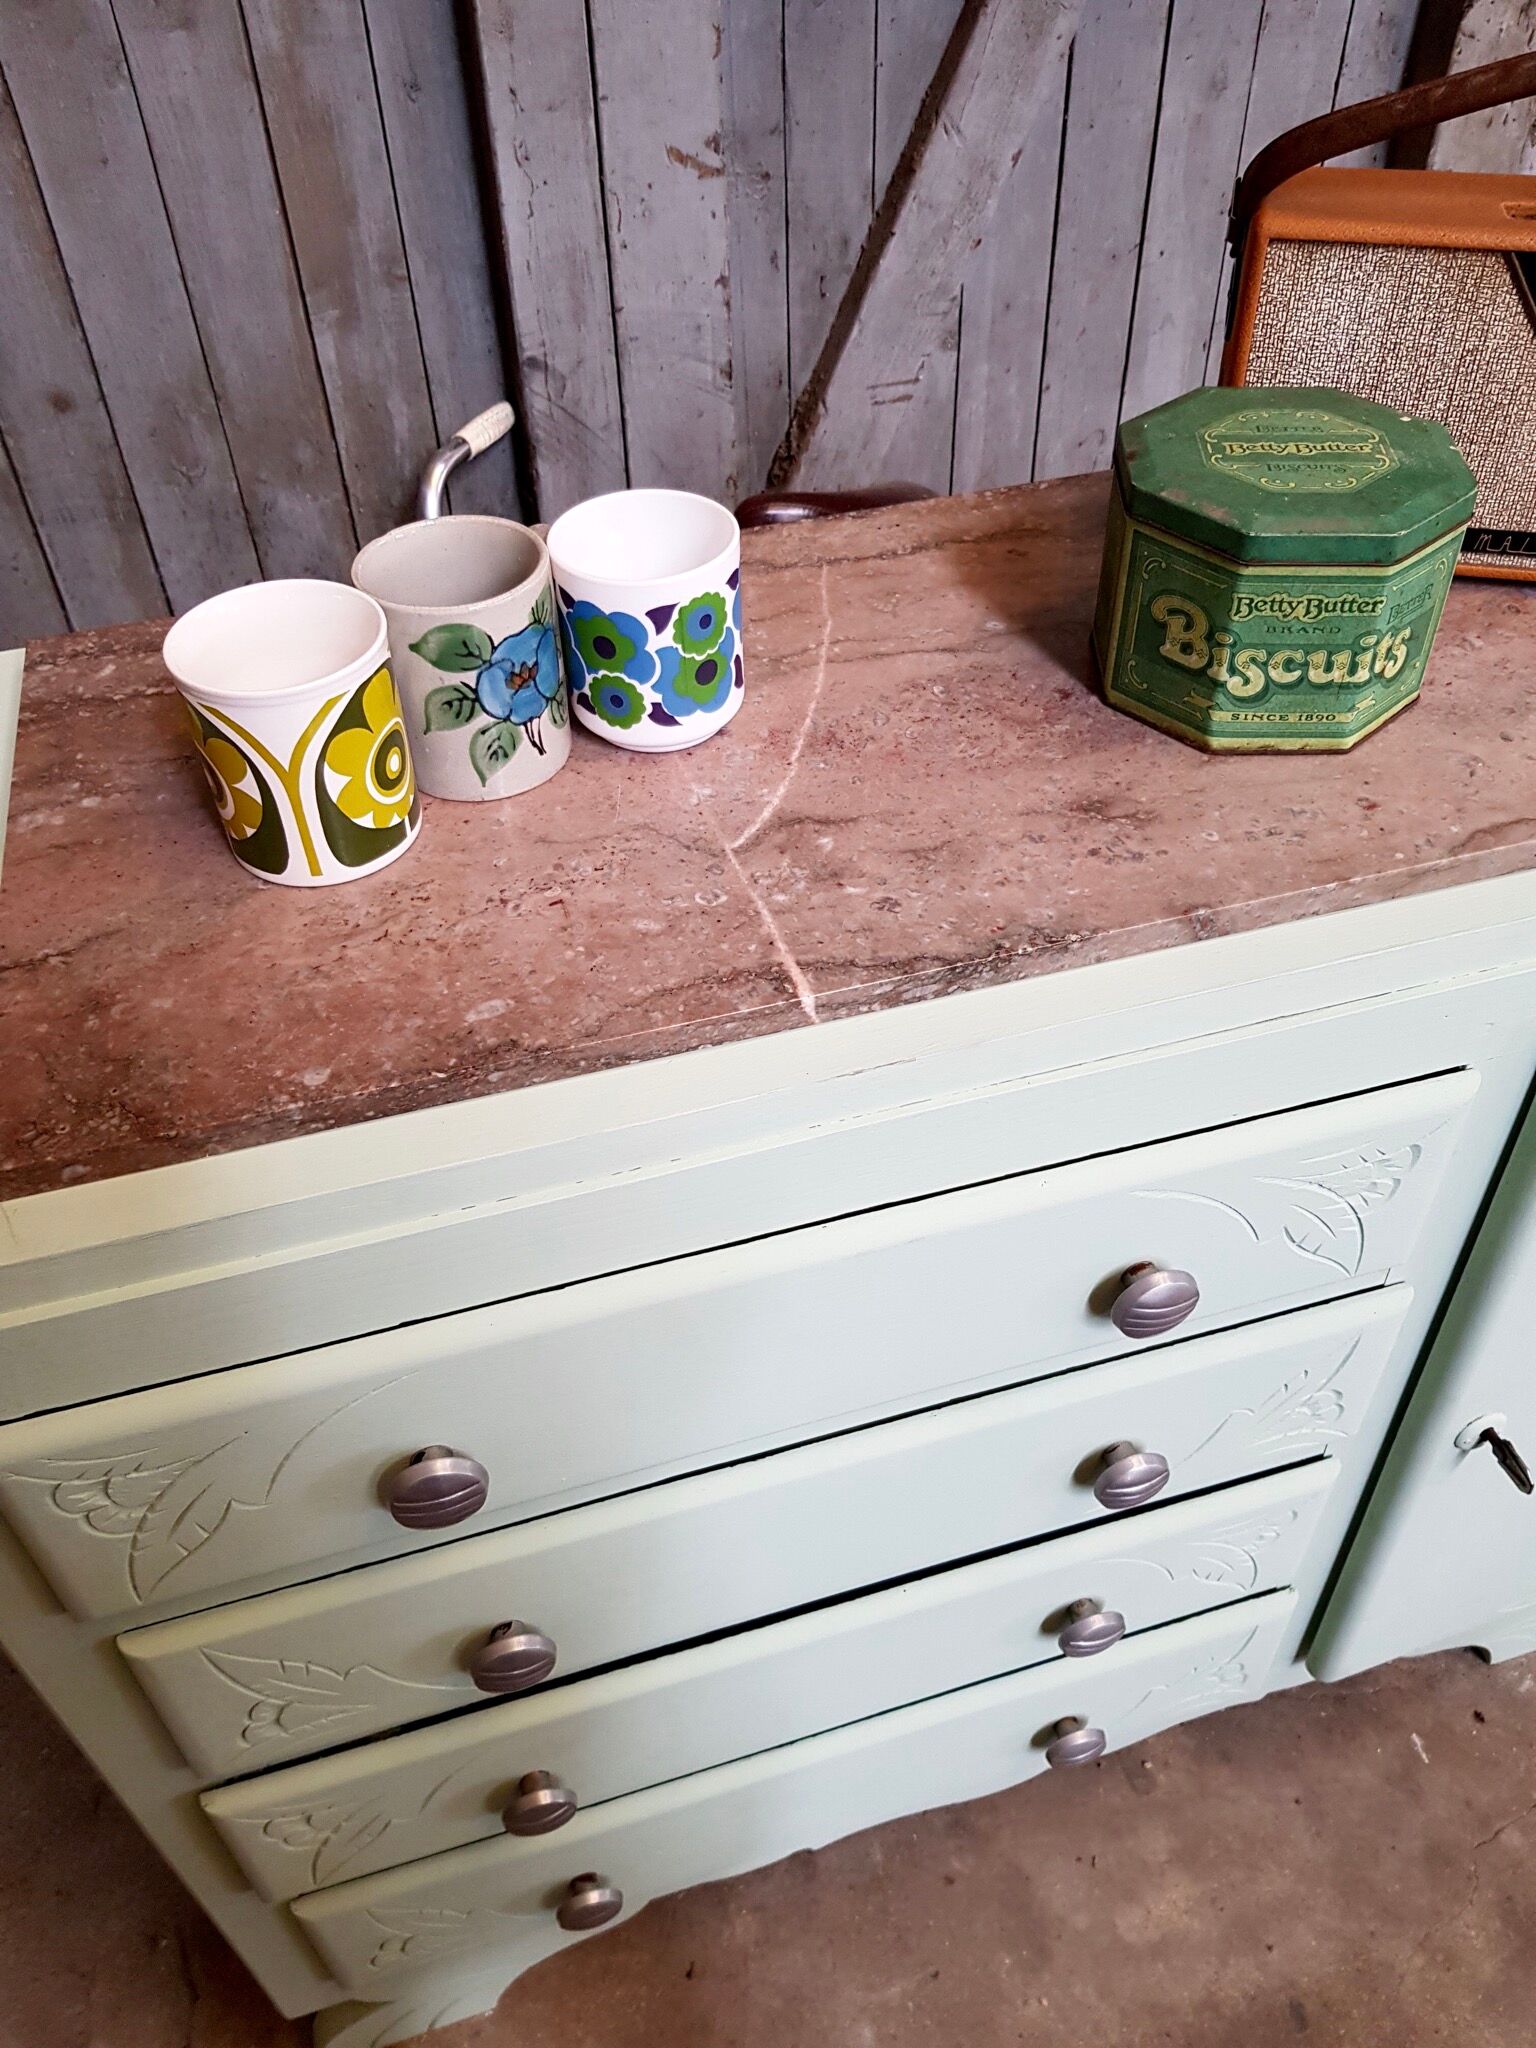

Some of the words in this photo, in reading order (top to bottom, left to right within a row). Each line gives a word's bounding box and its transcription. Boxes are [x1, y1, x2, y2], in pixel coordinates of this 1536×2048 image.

[1228, 443, 1289, 455] Betty
[1294, 443, 1372, 455] Butter
[1233, 596, 1300, 619] Betty
[1304, 596, 1385, 619] Butter
[1266, 625, 1342, 635] BRAND
[1151, 594, 1412, 697] Biscuits
[1230, 712, 1290, 722] SINCE
[1297, 712, 1337, 723] 1890
